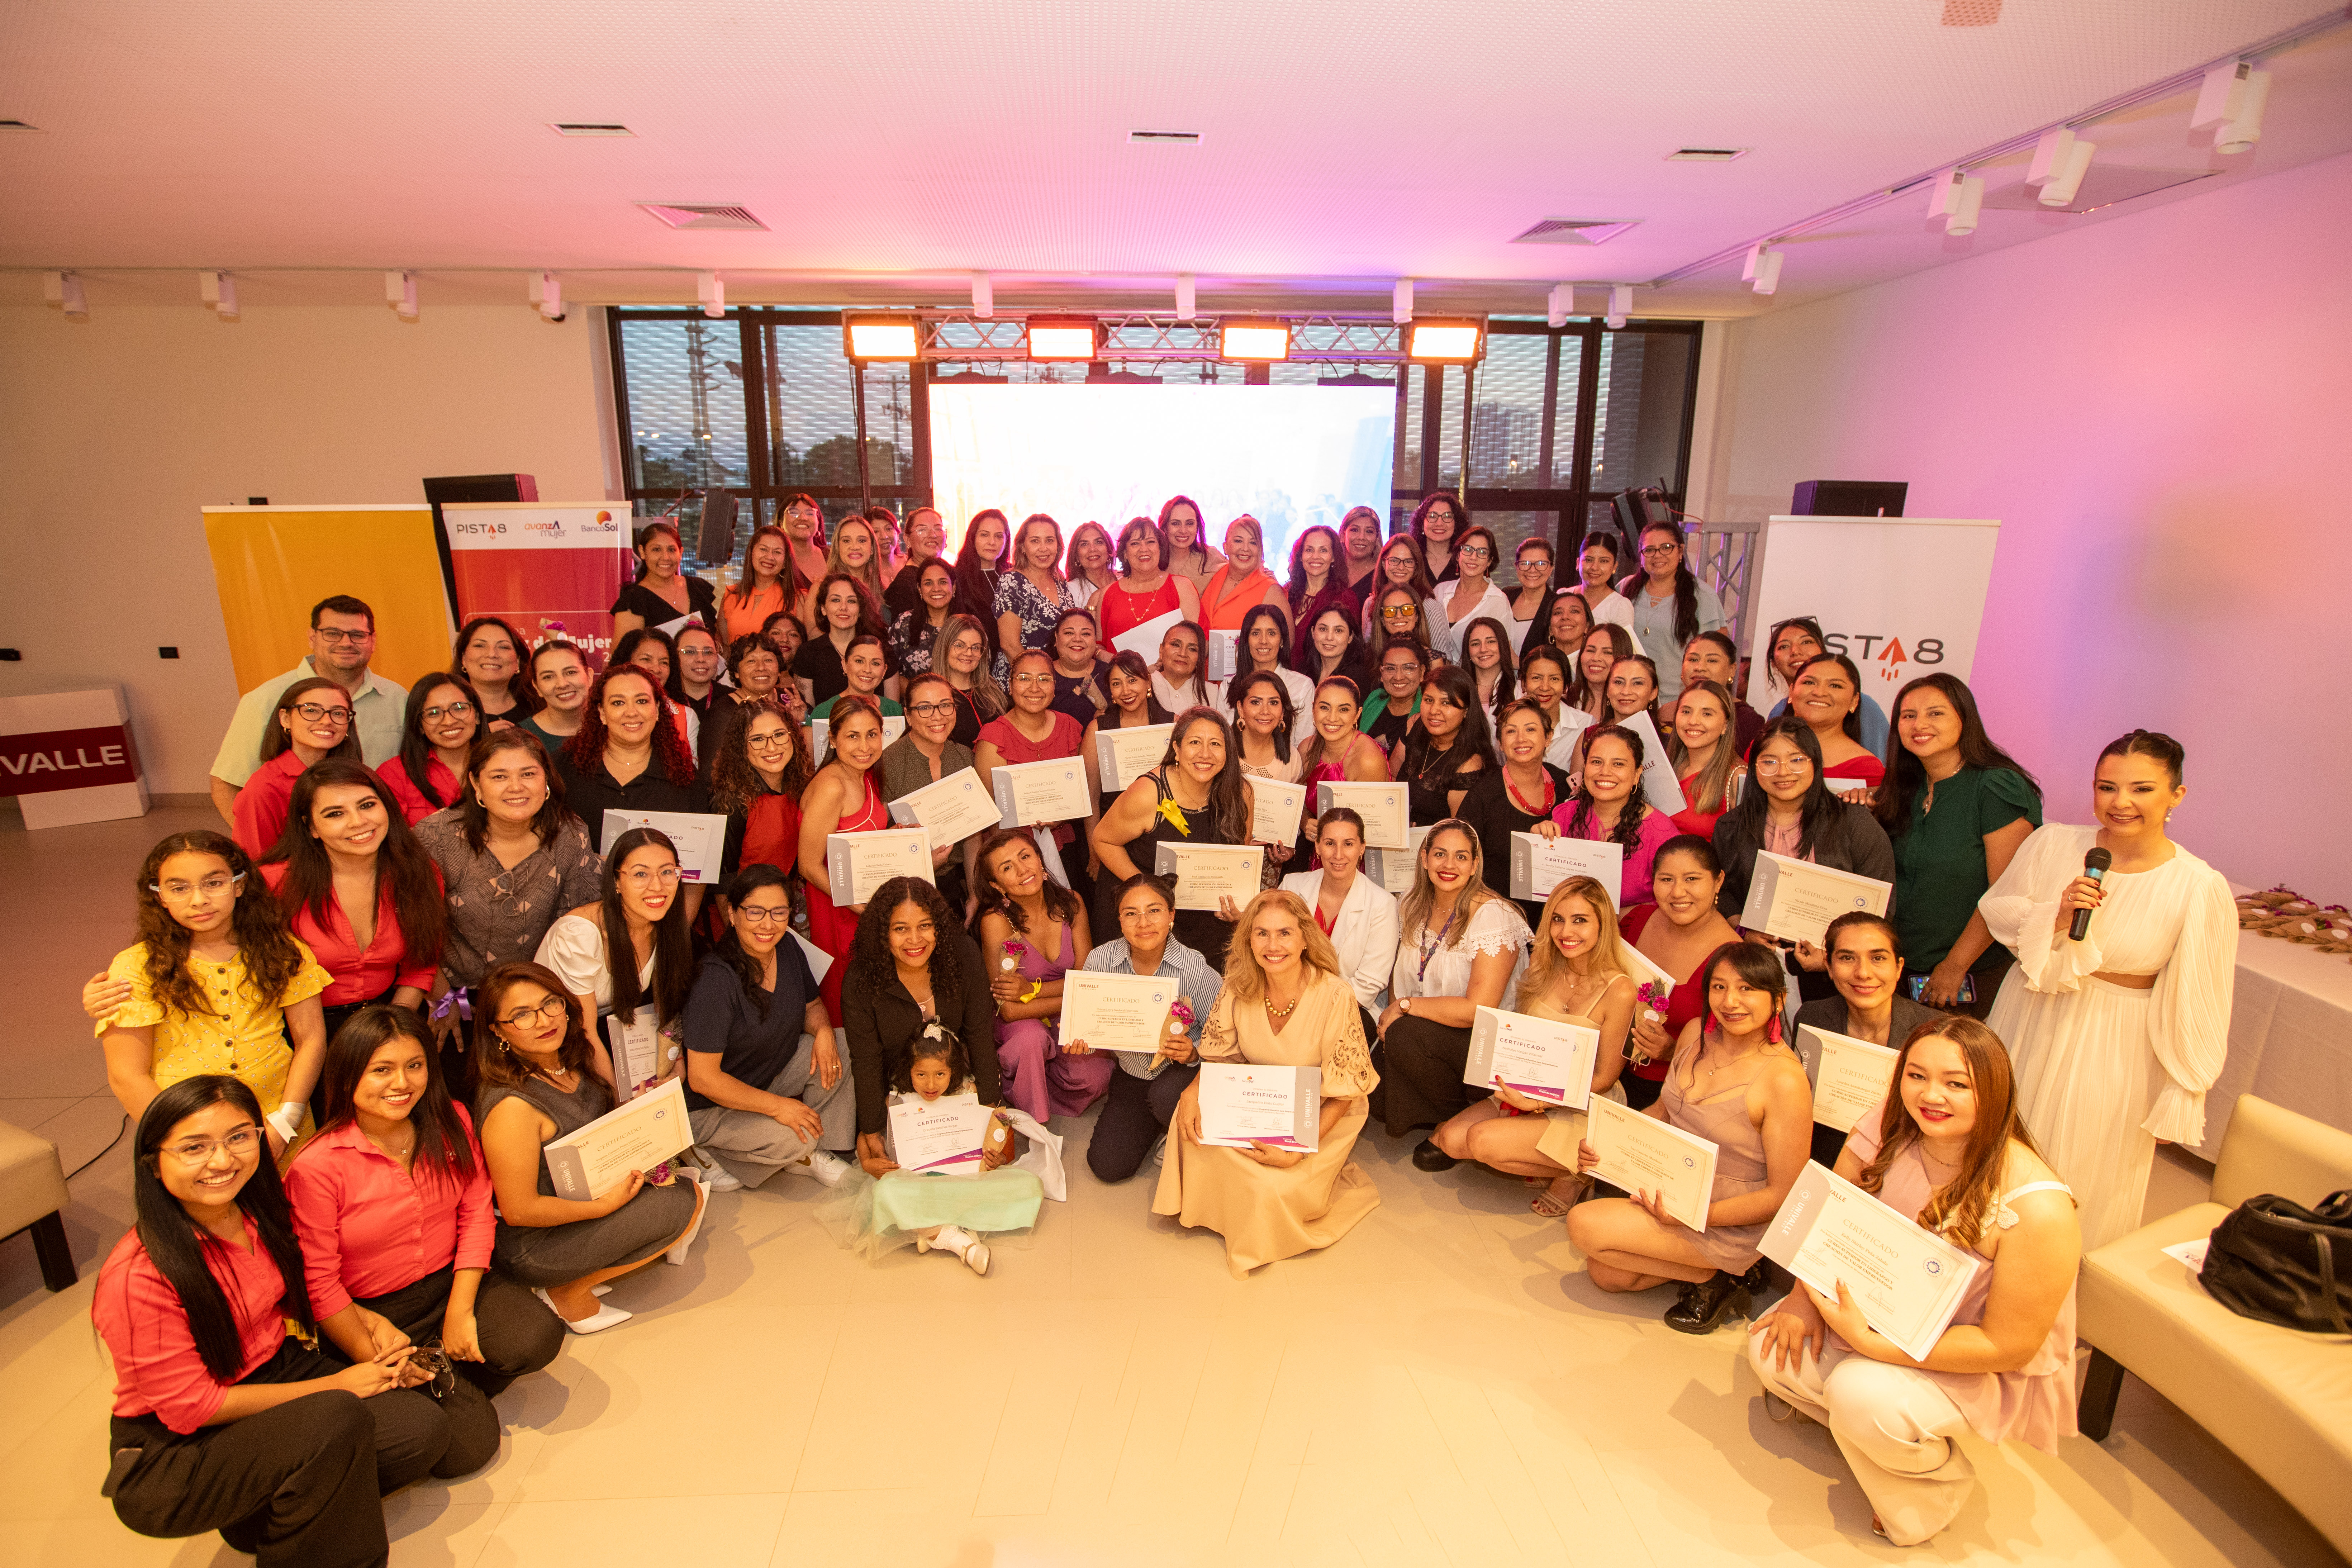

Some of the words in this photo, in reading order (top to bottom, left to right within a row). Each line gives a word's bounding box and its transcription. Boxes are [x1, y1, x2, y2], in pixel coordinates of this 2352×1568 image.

[541, 528, 566, 538] mujer
[581, 523, 618, 532] BancoSol
[0, 745, 125, 775] VALLE
[1642, 761, 1655, 771] ALLE
[1025, 780, 1056, 788] CERTIFICADO
[928, 796, 958, 812] CERTIFICADO
[1545, 857, 1587, 867] CERTIFICADO
[1755, 882, 1765, 909] UNIVALLE
[1794, 888, 1839, 903] CERTIFICADO
[1476, 1037, 1485, 1065] UNIVALLE
[1500, 1038, 1546, 1051] CERTIFICADO
[1839, 1067, 1891, 1087] CERTIFICADO
[917, 1116, 959, 1126] CERTIFICADO
[1604, 1109, 1625, 1122] UNIVALLE
[597, 1125, 641, 1152] CERTIFICADO
[1627, 1135, 1669, 1159] CERTIFICADO
[564, 1168, 575, 1192] UNIVALLE
[1640, 1165, 1663, 1178] EMPRENDEDOR
[1781, 1201, 1805, 1236] UNIVALLE
[1842, 1218, 1900, 1259] CERTIFICADO
[1840, 1232, 1851, 1241] Kelly
[1850, 1239, 1865, 1251] Shirley
[1875, 1255, 1889, 1266] Zabala
[1822, 1241, 1843, 1256] CREACIÓN
[1848, 1258, 1863, 1270] VALOR
[1862, 1268, 1894, 1291] EMPRENDEDOR
[1826, 1238, 1841, 1249] CURSO
[1840, 1247, 1861, 1263] SUPERIOR
[1866, 1265, 1890, 1282] LIDERAZGO
